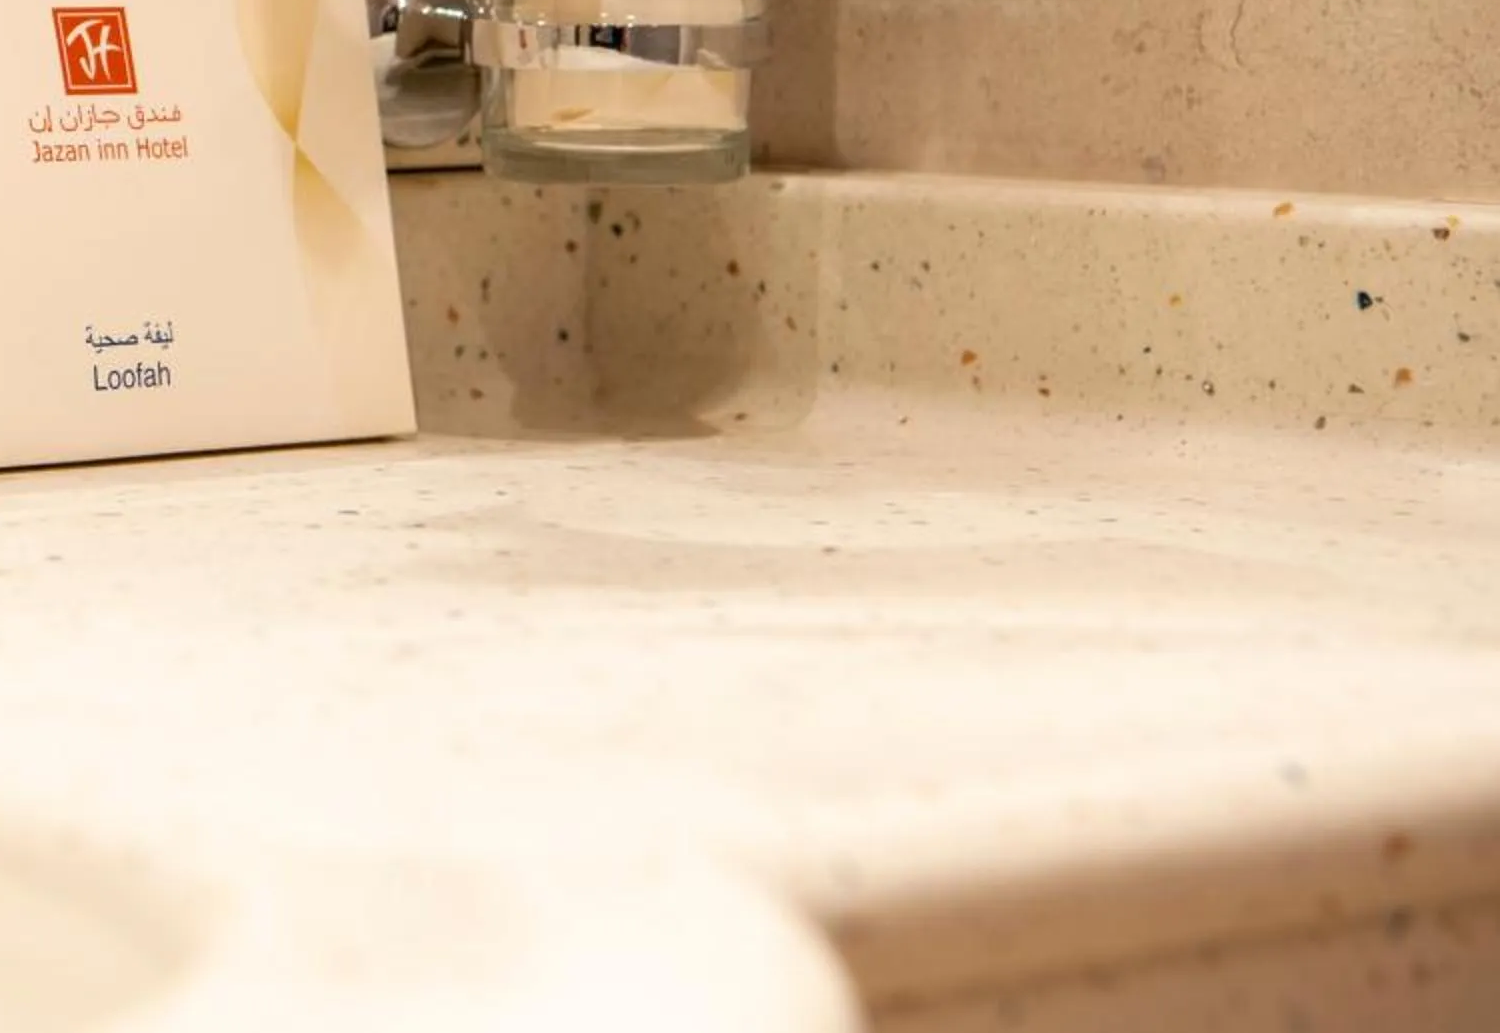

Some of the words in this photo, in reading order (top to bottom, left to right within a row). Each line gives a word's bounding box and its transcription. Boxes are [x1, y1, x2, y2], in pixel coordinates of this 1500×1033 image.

[58, 103, 122, 133] جازان
[126, 103, 183, 131] فندق
[32, 139, 92, 164] Jazan
[97, 137, 129, 161] inn
[135, 134, 189, 160] Hotel
[84, 325, 139, 355] صحية
[143, 320, 175, 350] ليفة
[93, 360, 172, 392] Loofah
